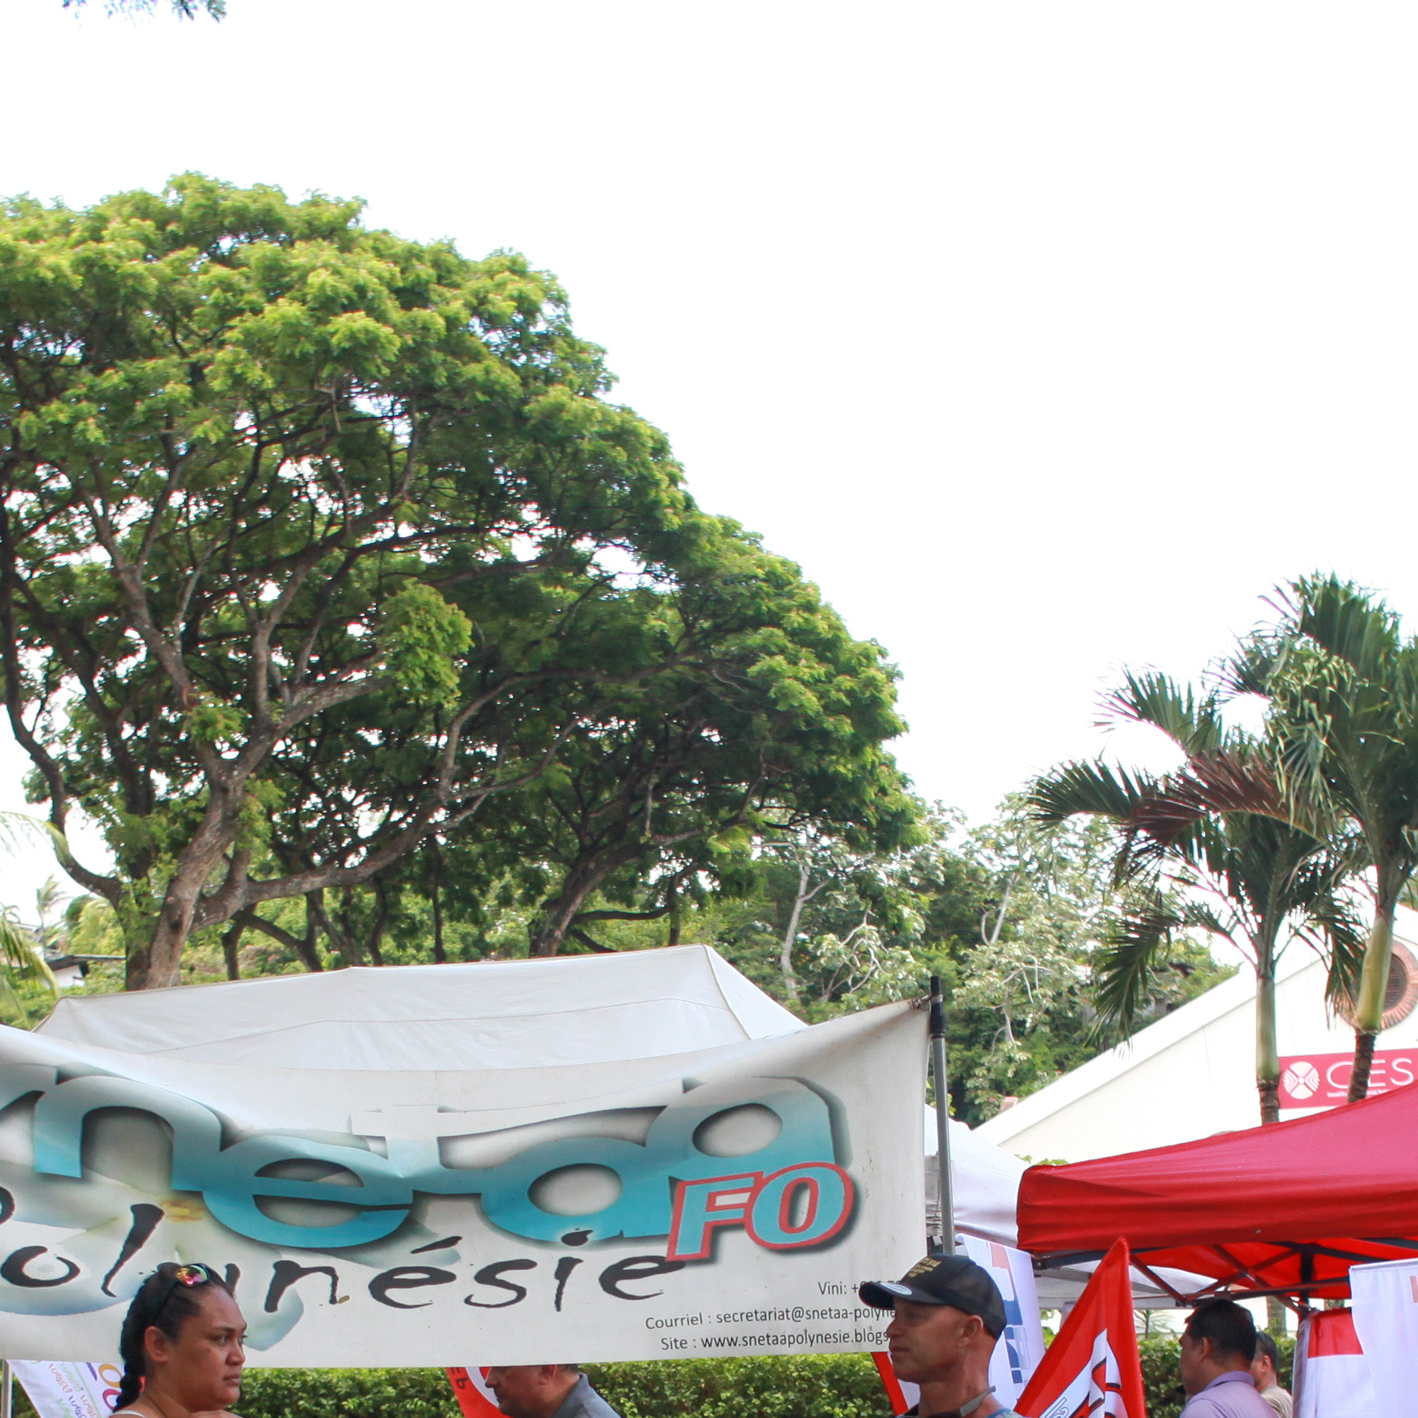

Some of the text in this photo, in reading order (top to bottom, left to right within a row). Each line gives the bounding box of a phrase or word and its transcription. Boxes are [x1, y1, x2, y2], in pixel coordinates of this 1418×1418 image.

[667, 1161, 854, 1262] FO
[817, 1281, 847, 1295] Vini:
[645, 1312, 704, 1330] Courriel
[661, 1336, 688, 1350] Site
